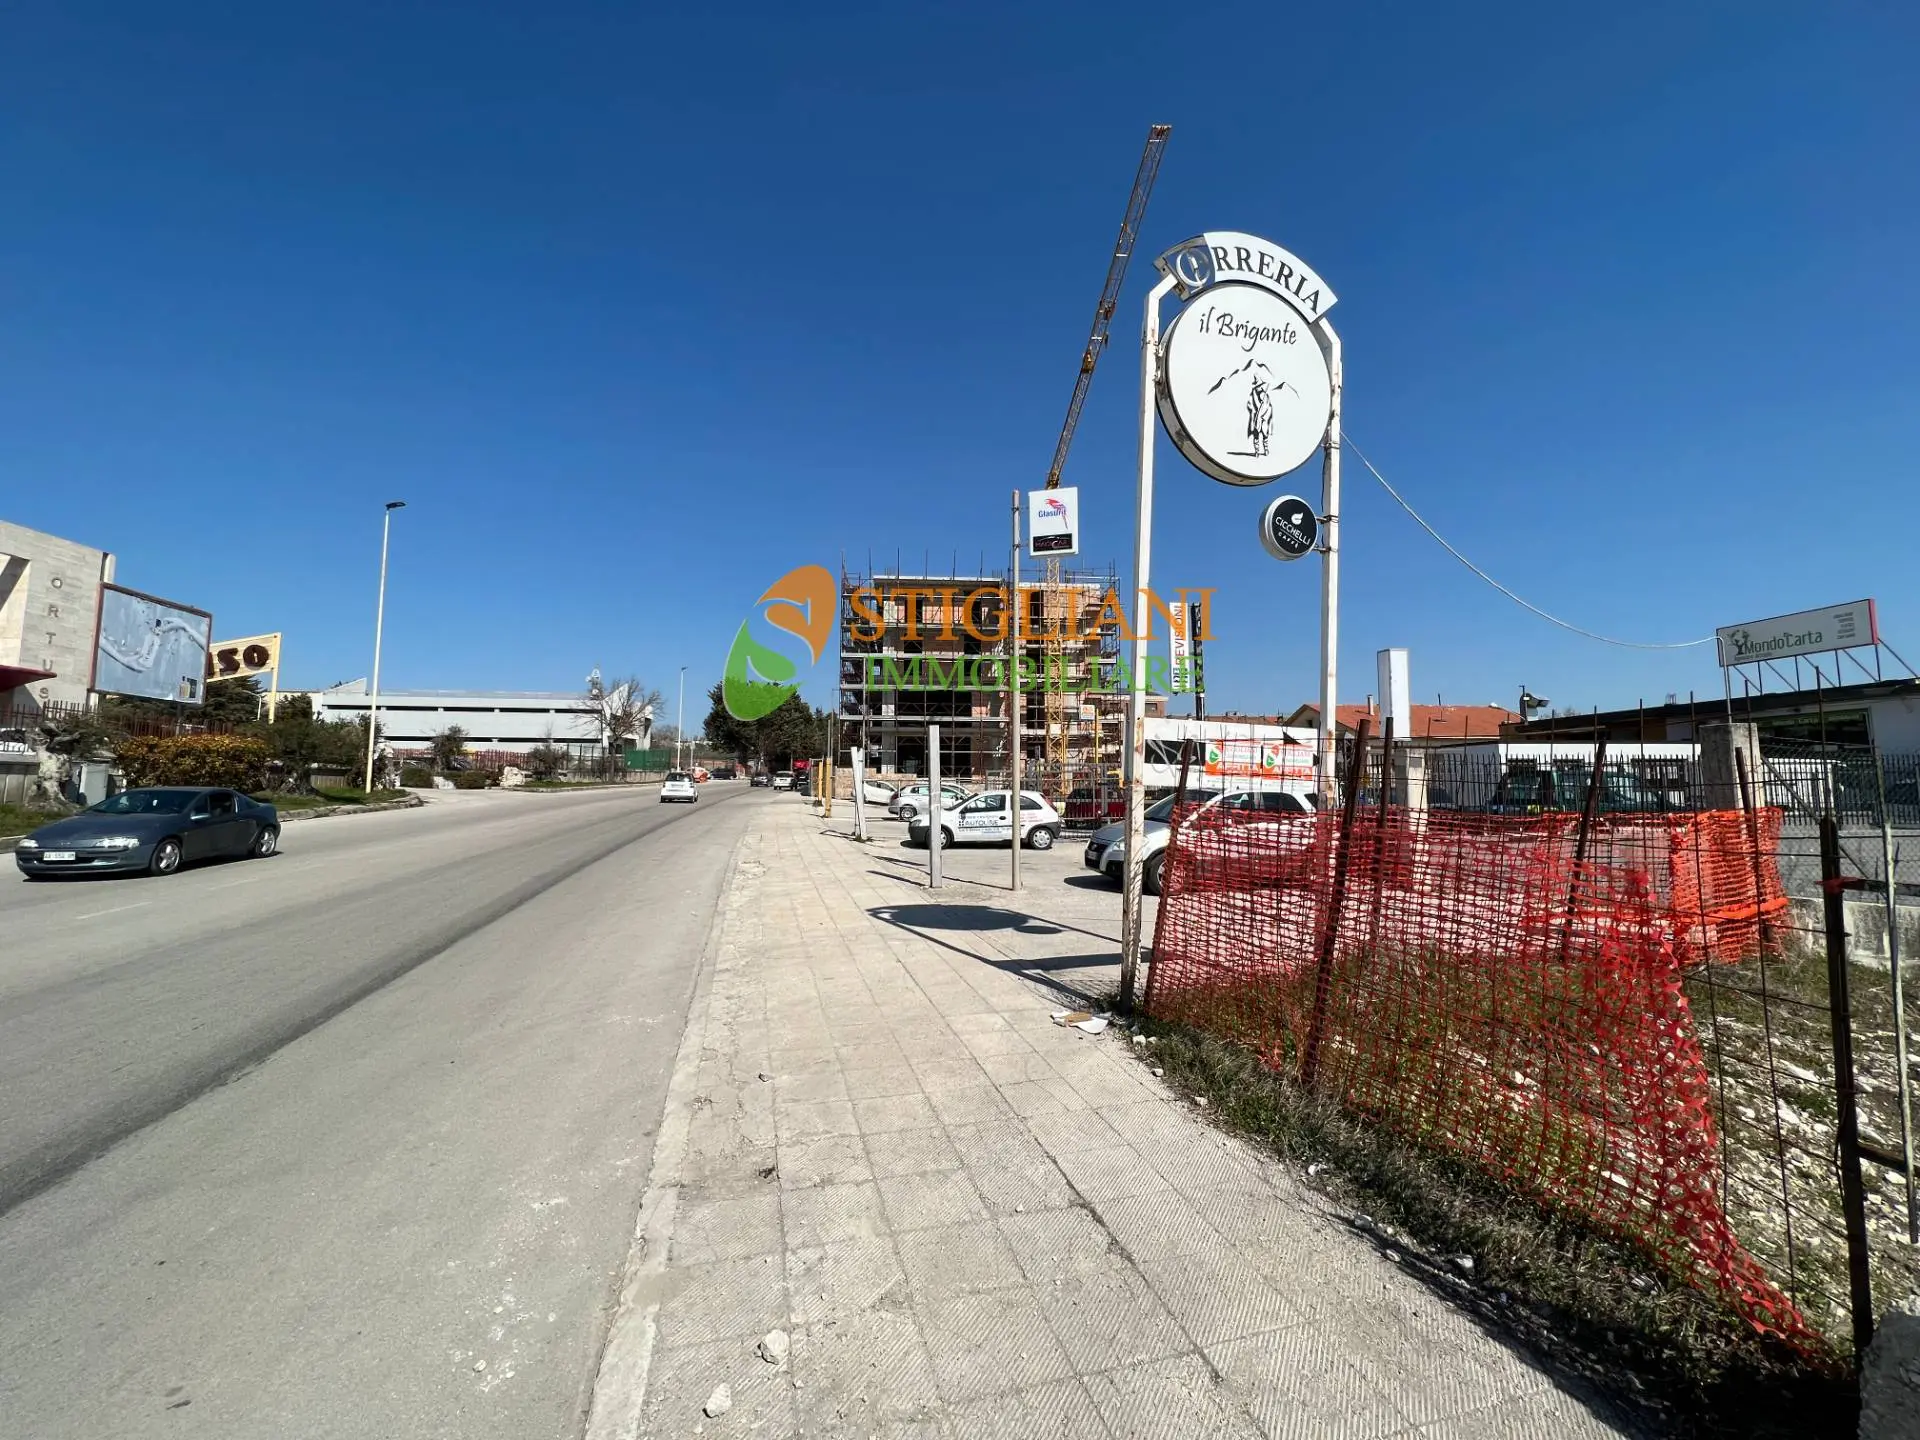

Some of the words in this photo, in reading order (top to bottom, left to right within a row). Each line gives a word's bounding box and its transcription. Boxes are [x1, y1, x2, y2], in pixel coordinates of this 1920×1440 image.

[1199, 306, 1216, 334] il
[1217, 312, 1297, 352] Brigante
[1275, 516, 1311, 546] CICCHELLI
[38, 576, 63, 700] ORTUS
[207, 643, 271, 679] SO
